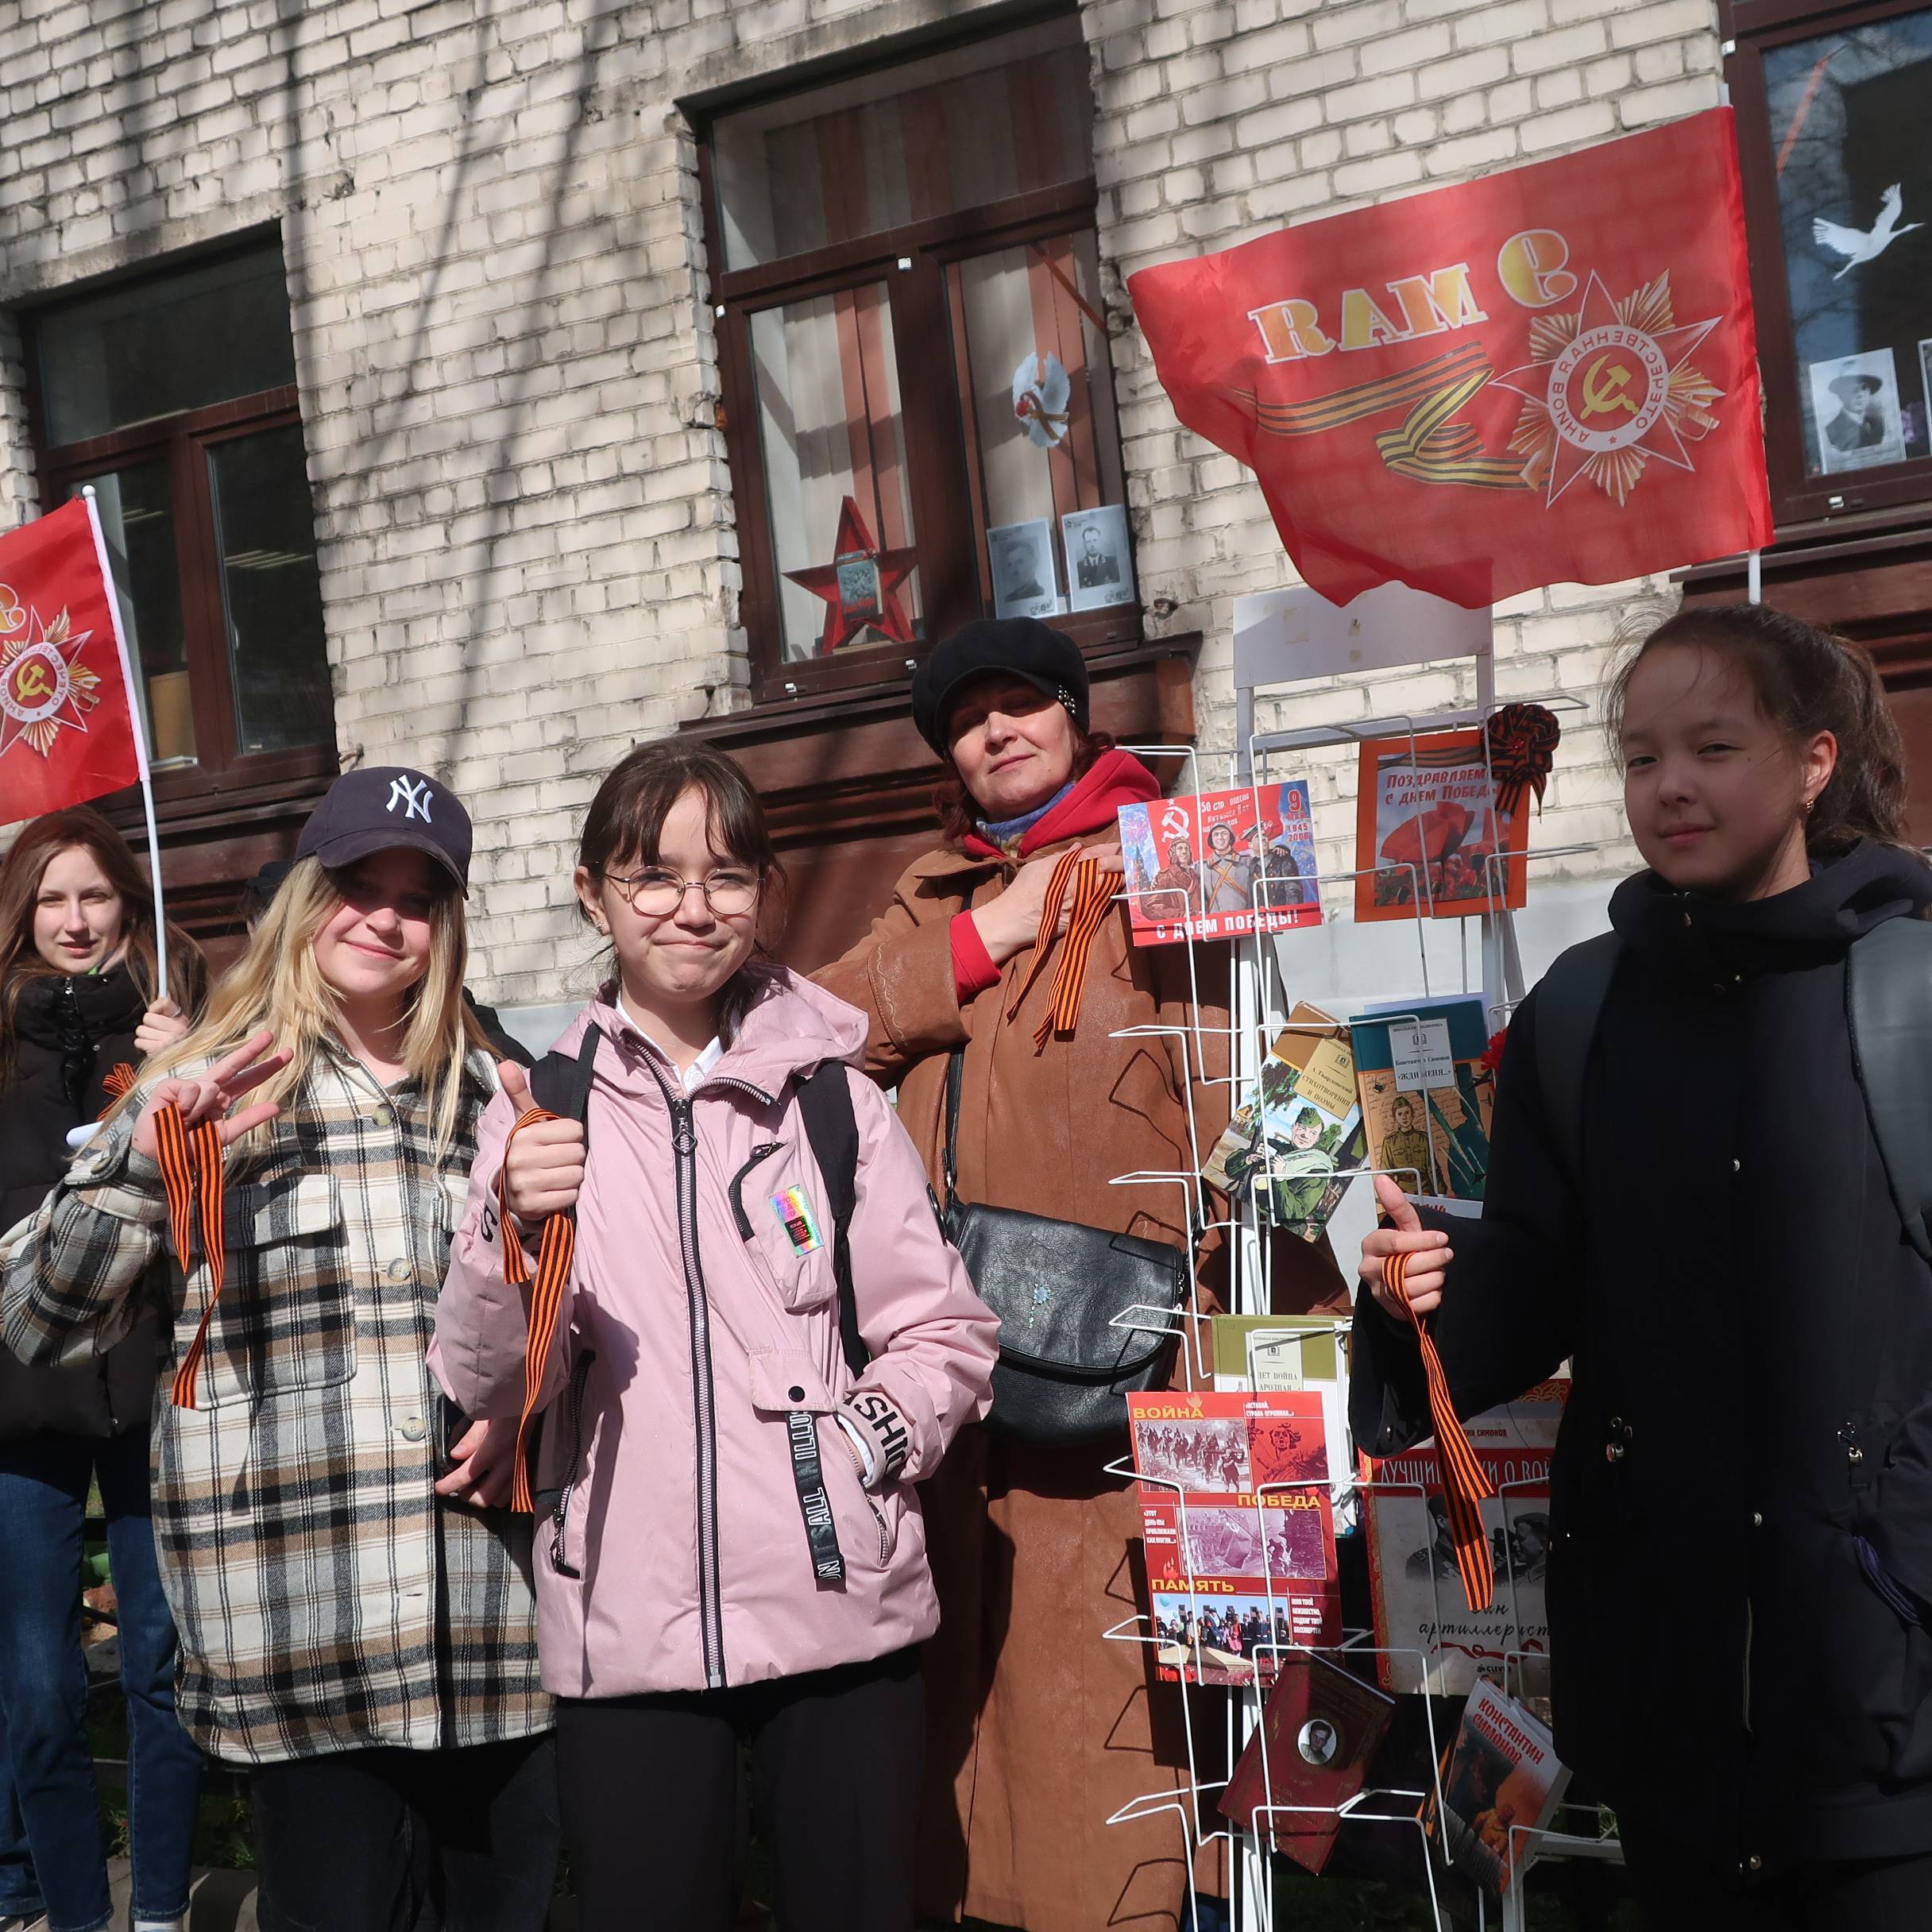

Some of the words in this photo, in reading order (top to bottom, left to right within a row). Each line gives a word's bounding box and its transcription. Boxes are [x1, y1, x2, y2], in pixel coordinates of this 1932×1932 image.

[385, 774, 434, 824] NY
[1288, 789, 1301, 812] 9
[1288, 823, 1308, 833] 1945
[1156, 924, 1166, 940] С
[1225, 909, 1299, 932] ПОБЕДЫ!
[1273, 1371, 1298, 1381] ВОЙНА
[1133, 1405, 1205, 1420] ВОЙНА
[1505, 1460, 1514, 1483] О
[803, 1486, 832, 1526] ALL
[1238, 1493, 1321, 1510] ПОБЕДА
[1152, 1578, 1235, 1593] ПАМЯТЬ
[1473, 1714, 1524, 1765] СИМОНОВ
[1478, 1698, 1545, 1766] КОНСТАНТИН
